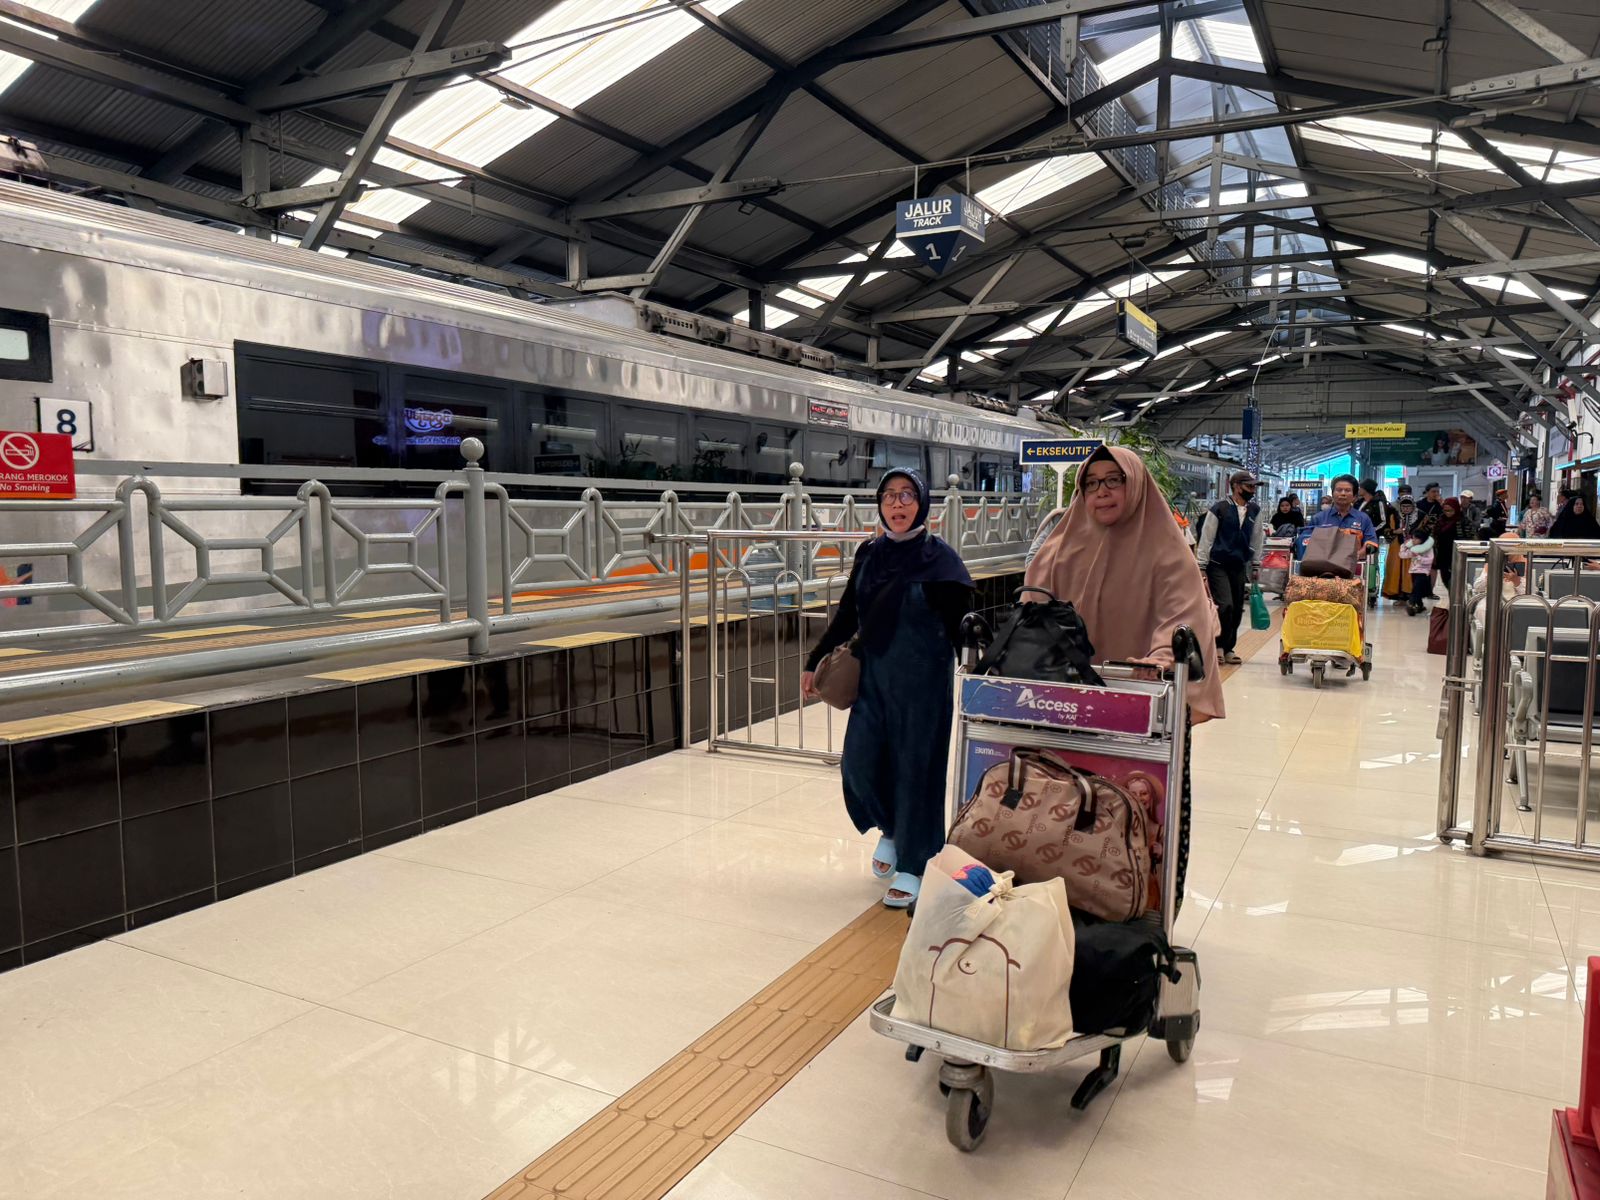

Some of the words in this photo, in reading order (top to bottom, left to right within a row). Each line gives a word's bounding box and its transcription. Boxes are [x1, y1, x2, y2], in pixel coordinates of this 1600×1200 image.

[905, 199, 952, 218] JALUR
[963, 201, 982, 221] JALUR
[913, 216, 942, 228] TRACK
[925, 243, 941, 260] 1
[952, 245, 967, 261] 1
[57, 409, 76, 435] 8
[1036, 446, 1092, 456] EKSEKUTIF
[27, 474, 68, 482] MEROKOK
[15, 484, 50, 493] Smoking
[1016, 688, 1079, 713] Access
